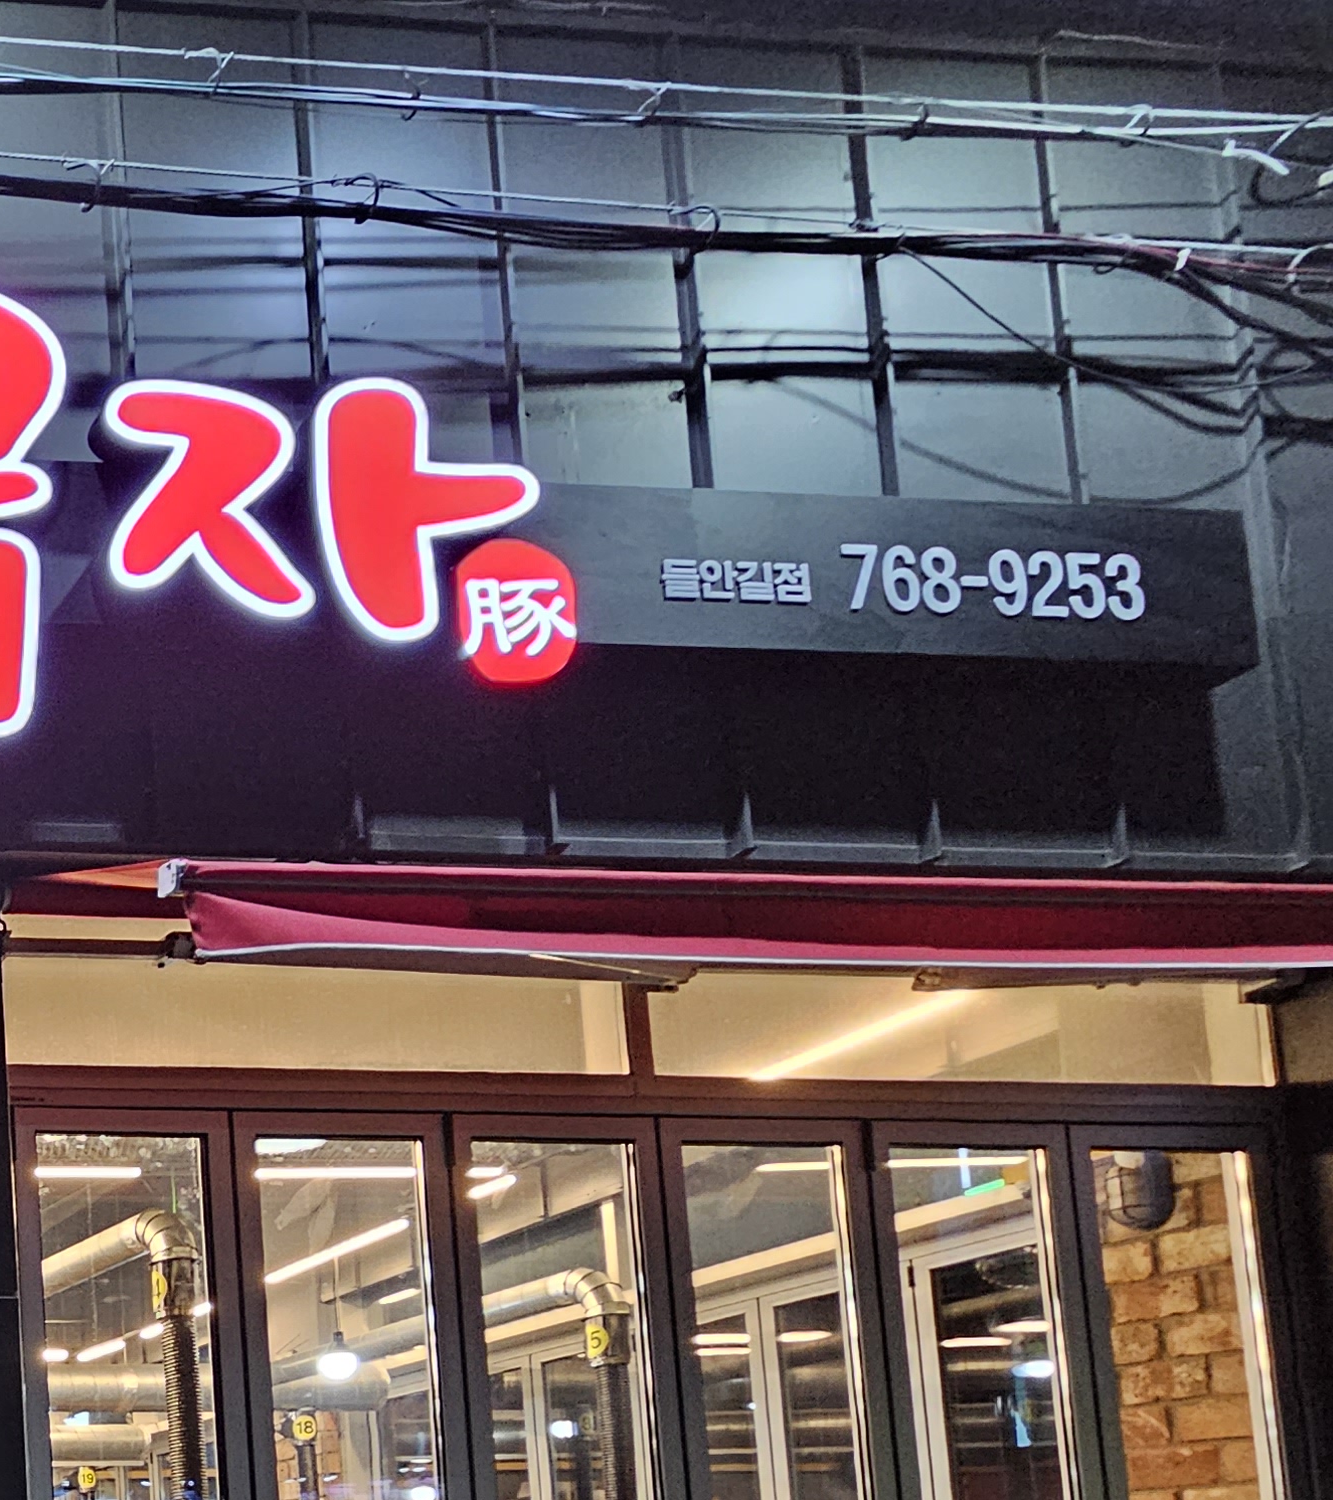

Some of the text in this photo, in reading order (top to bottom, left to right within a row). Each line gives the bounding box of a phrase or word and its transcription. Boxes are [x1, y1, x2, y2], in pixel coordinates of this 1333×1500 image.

[661, 541, 1146, 621] 들안길점 768-9253
[459, 576, 578, 658] 豚
[590, 1330, 602, 1349] 5
[296, 1420, 314, 1434] 18
[81, 1473, 94, 1484] 19
